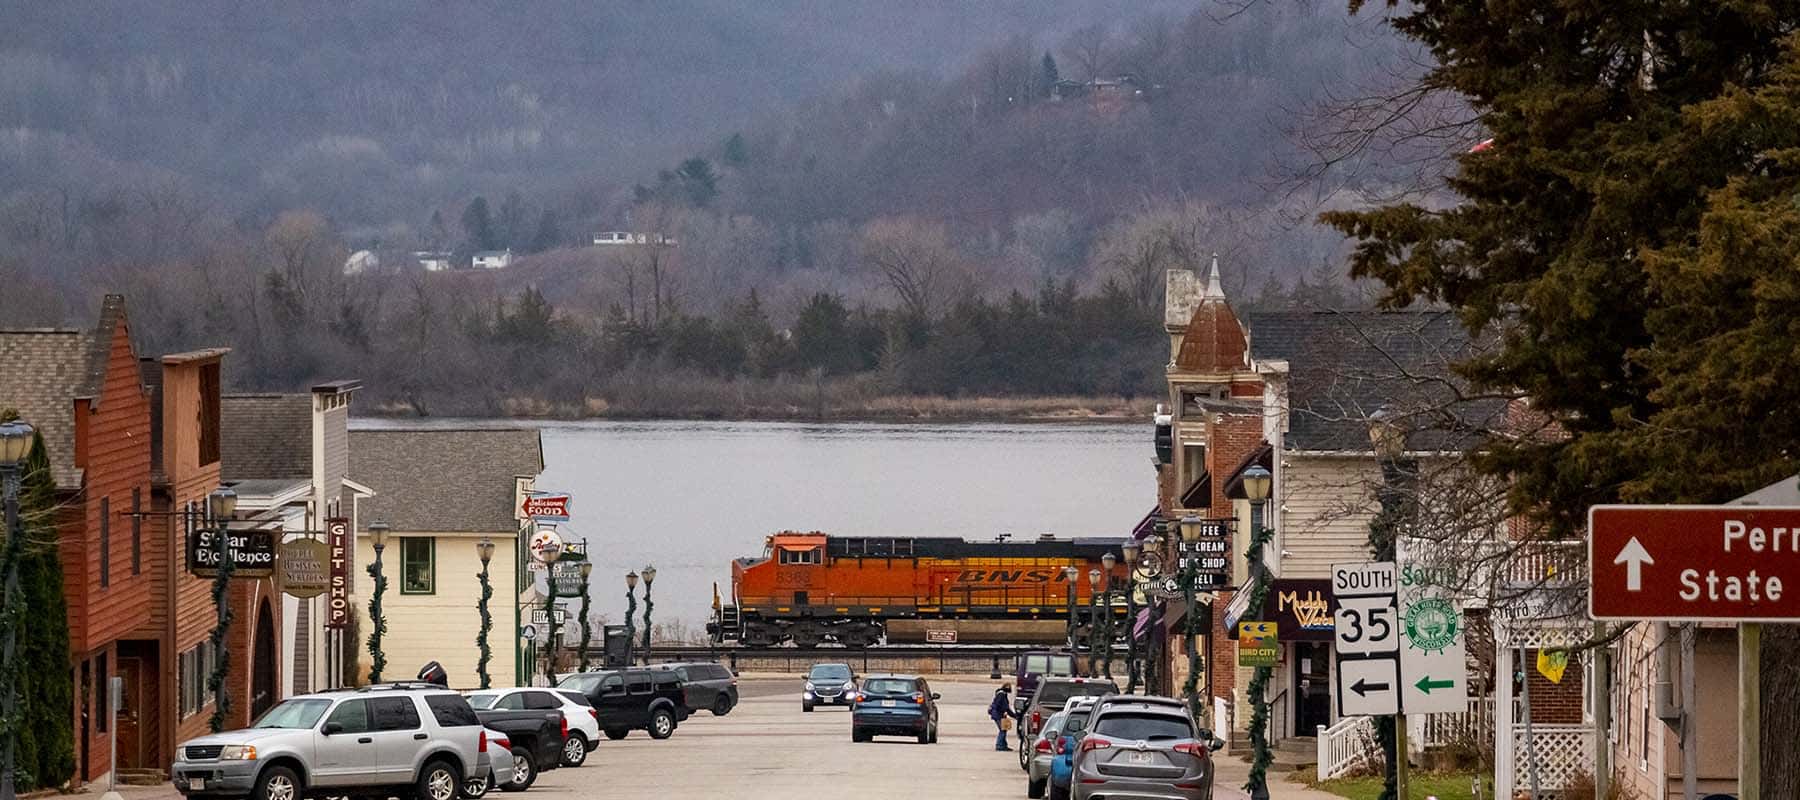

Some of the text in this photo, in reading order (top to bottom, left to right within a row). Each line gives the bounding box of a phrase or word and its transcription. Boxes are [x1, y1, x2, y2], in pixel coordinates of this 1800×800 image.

[528, 507, 562, 515] FOOD
[199, 531, 248, 547] Sar
[1195, 542, 1225, 552] CREAM
[196, 548, 271, 565] Excllence
[1202, 558, 1225, 568] SHOP
[331, 525, 346, 620] GIFT SHOP
[1336, 568, 1393, 589] SOUTH
[1679, 567, 1783, 601] State
[1278, 590, 1328, 612] Muddy
[1498, 601, 1529, 619] Third
[1340, 608, 1391, 643] 35
[1258, 648, 1276, 657] CITY
